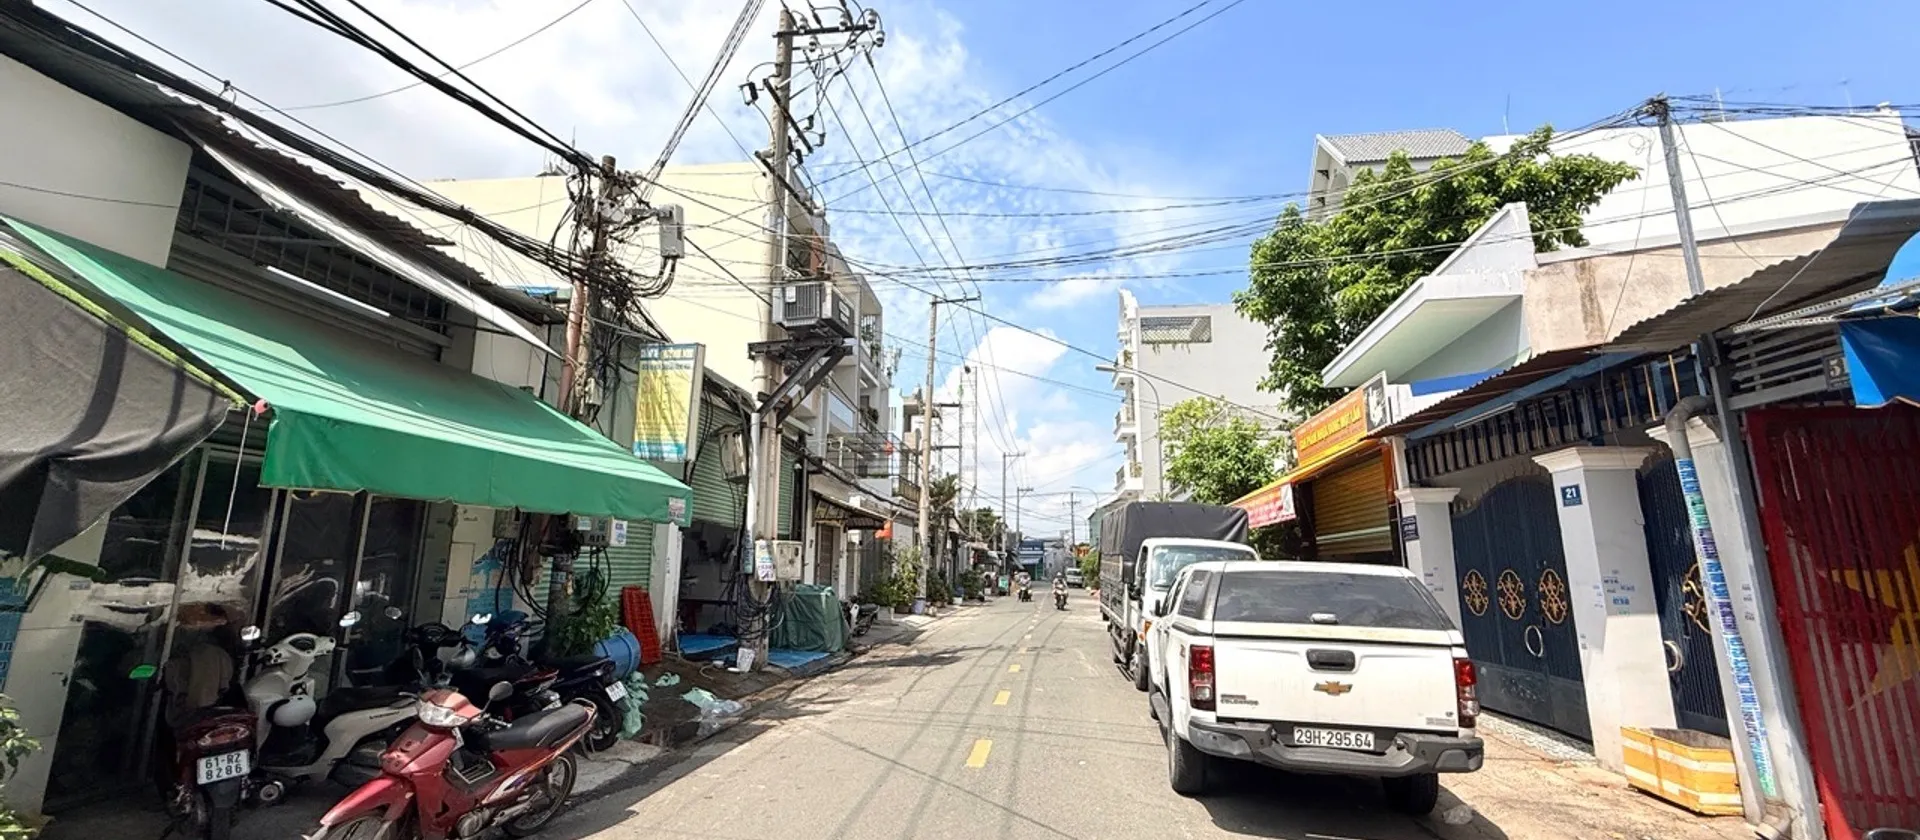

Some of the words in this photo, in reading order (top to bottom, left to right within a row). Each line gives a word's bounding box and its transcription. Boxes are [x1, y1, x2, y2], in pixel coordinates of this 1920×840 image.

[1565, 487, 1577, 499] 21
[1296, 729, 1371, 748] 29H-295.64
[205, 764, 242, 780] 8286
